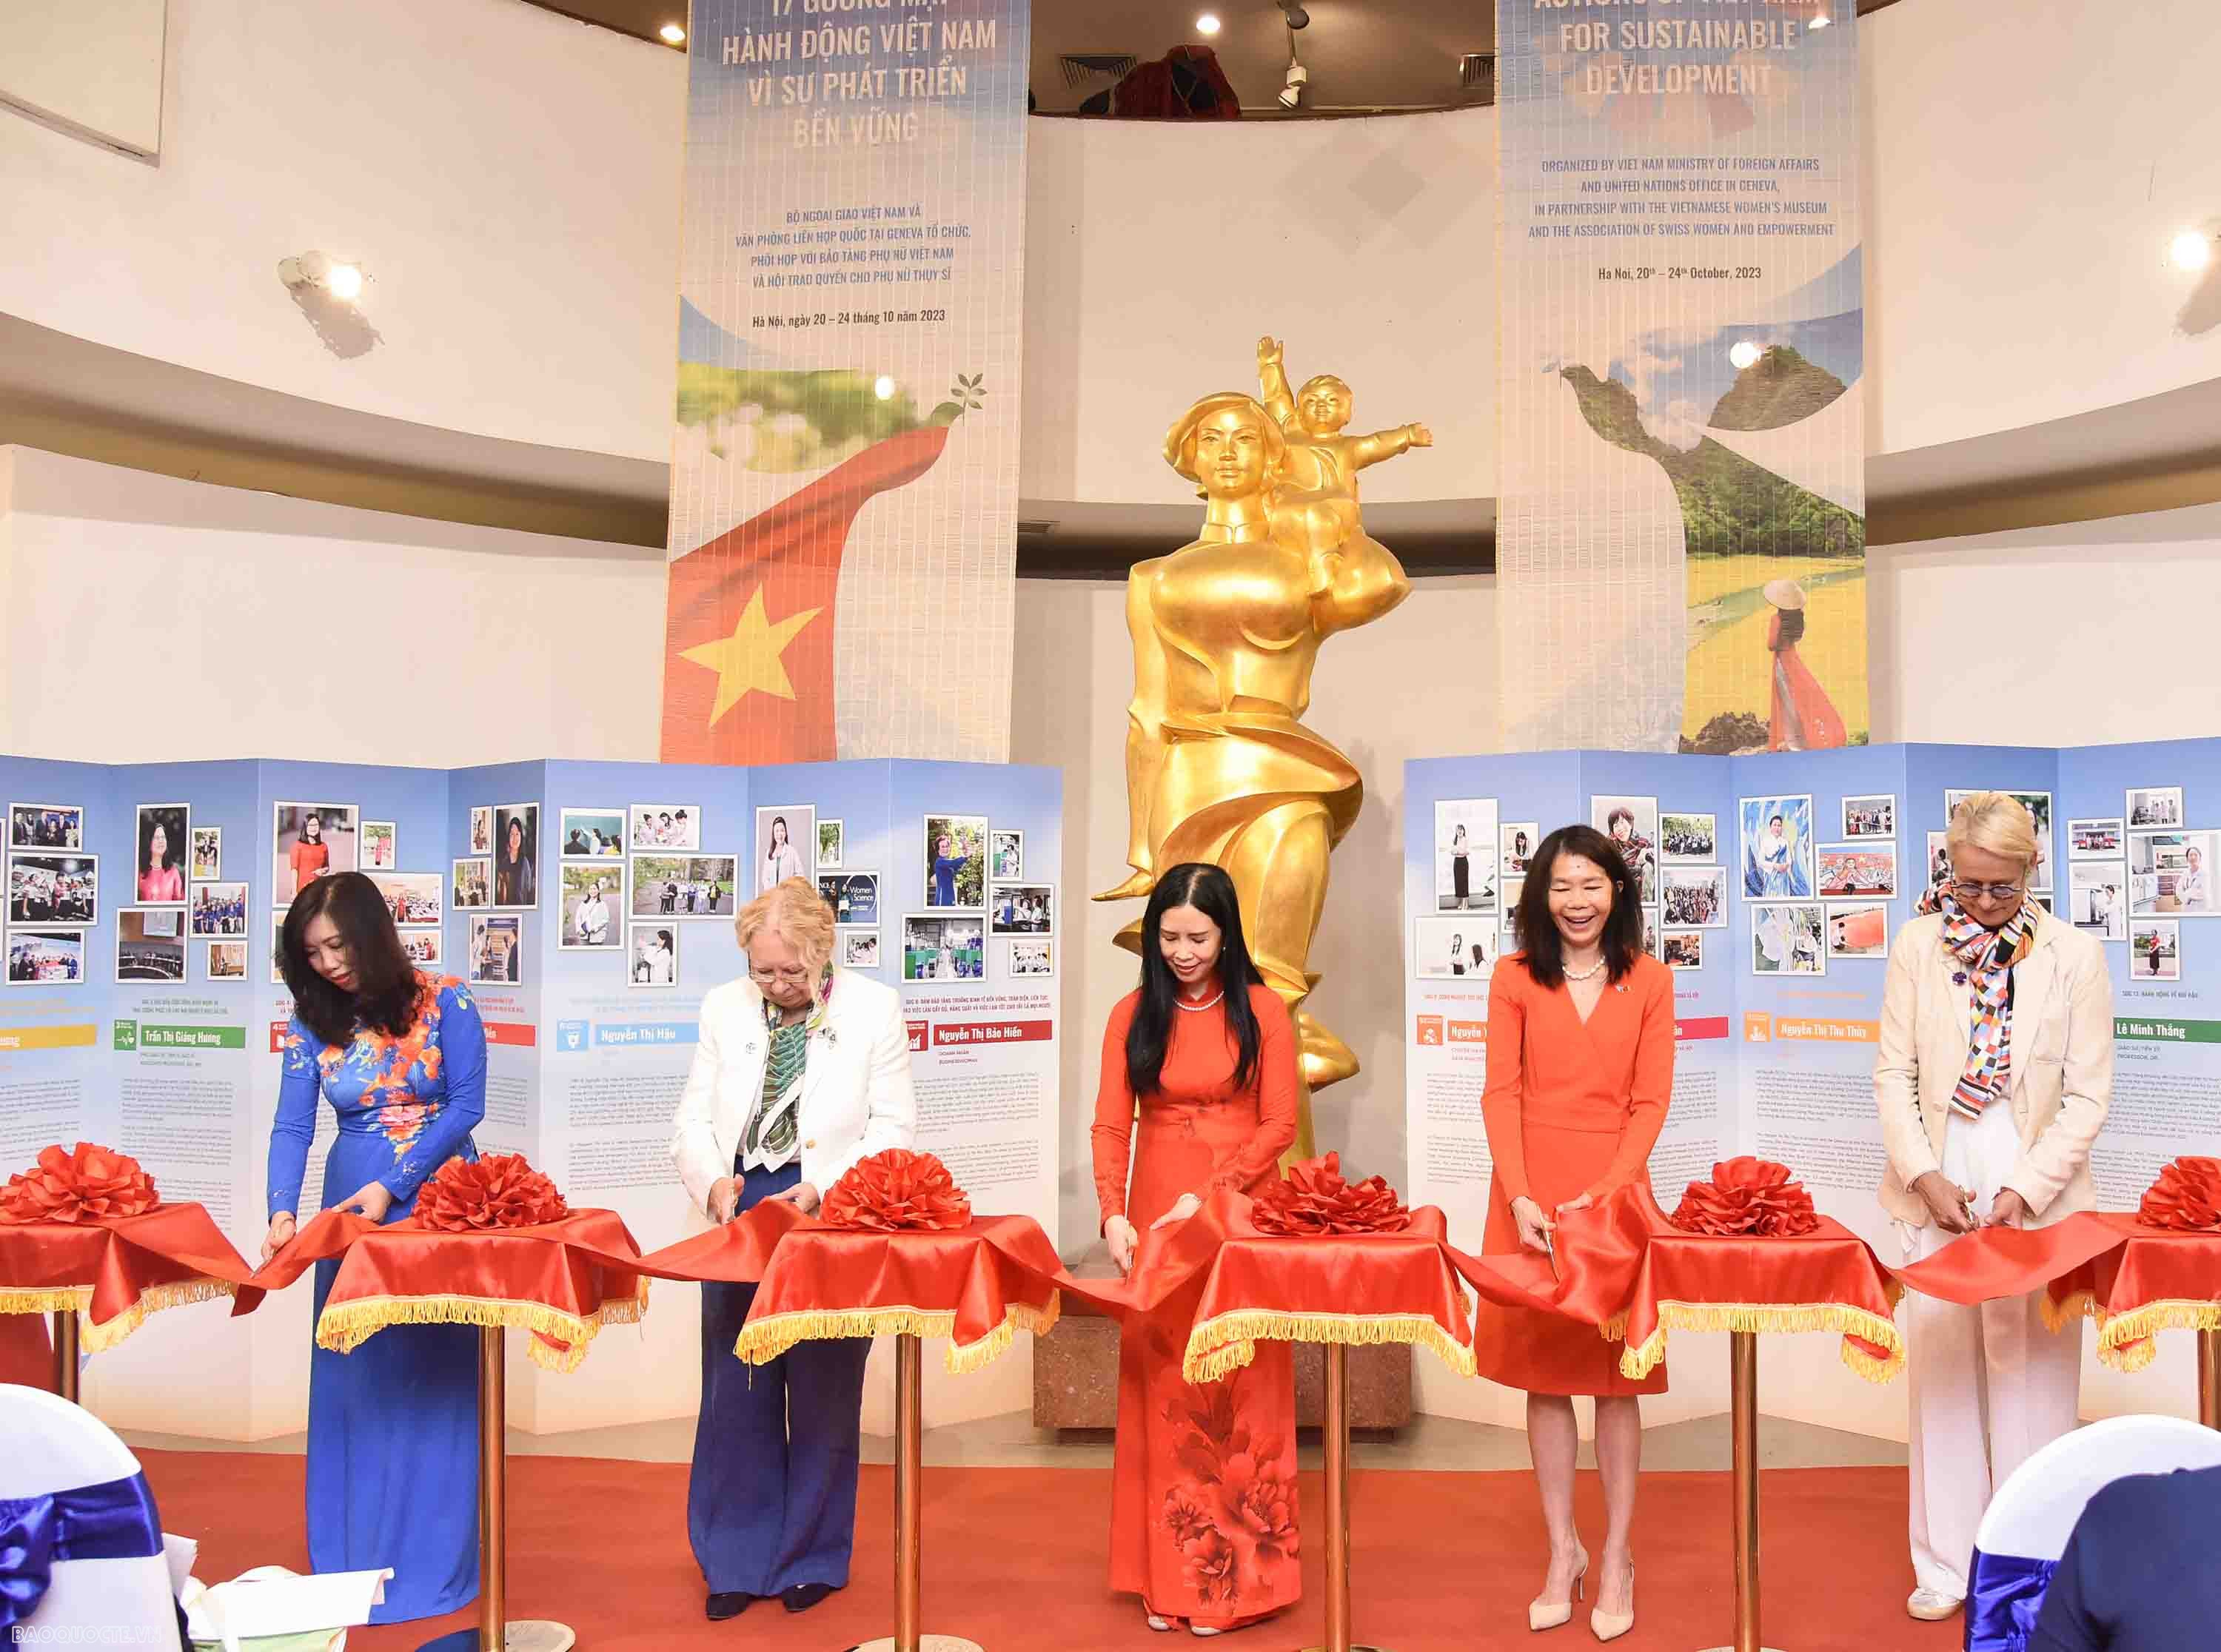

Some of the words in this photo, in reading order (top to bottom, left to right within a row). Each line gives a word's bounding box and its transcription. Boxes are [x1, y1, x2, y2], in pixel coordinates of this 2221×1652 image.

[722, 27, 792, 65] HÀNH
[800, 21, 871, 63] ĐỘNG
[880, 16, 933, 58] VIỆT
[942, 19, 996, 50] NAM
[1561, 22, 1610, 53] FOR
[1621, 19, 1795, 51] SUSTAINABLE
[748, 70, 771, 106] VÌ
[823, 62, 888, 101] PHÁT
[896, 54, 966, 97] TRIỂN
[1587, 64, 1771, 95] DEVELOPMENT
[1542, 159, 1598, 172] ORGANIZED
[1601, 159, 1614, 171] BY
[1618, 158, 1638, 170] VIET
[1642, 158, 1664, 170] NAM
[1667, 158, 1714, 170] MINISTRY
[1718, 158, 1730, 169] OF
[1733, 158, 1776, 170] FOREIGN
[1779, 158, 1819, 171] AFFAIRS
[1581, 181, 1601, 192] AND
[1604, 181, 1640, 192] UNITED
[1644, 180, 1686, 192] NATIONS
[1689, 180, 1722, 191] OFFICE
[1726, 180, 1735, 191] IN
[1740, 180, 1781, 193] GENEVA,
[787, 211, 800, 225] BỘ
[836, 209, 858, 221] GIAO
[862, 205, 882, 221] VIỆT
[884, 206, 905, 218] NAM
[909, 203, 920, 217] VÀ
[1534, 204, 1545, 216] IN
[1548, 202, 1617, 215] PARTNERSHIP
[1620, 202, 1645, 214] WITH
[1649, 202, 1666, 214] THE
[1670, 201, 1730, 213] VIETNAMESE
[1734, 201, 1780, 214] WOMEN'S
[1783, 201, 1827, 214] MUSEUM
[794, 229, 813, 244] LIÊN
[888, 226, 923, 240] GENEVA
[1529, 225, 1549, 238] AND
[1552, 225, 1570, 237] THE
[1574, 224, 1640, 236] ASSOCIATION
[1643, 224, 1655, 235] OF
[1658, 224, 1689, 235] SWISS
[1693, 224, 1729, 235] WOMEN
[1734, 224, 1754, 235] AND
[1758, 224, 1835, 235] EMPOWERMENT
[933, 248, 954, 260] NAM
[753, 273, 764, 288] VÀ
[788, 273, 812, 286] TRAO
[850, 272, 870, 283] CHO
[1598, 267, 1611, 280] Ha
[1615, 267, 1633, 281] Noi,
[1637, 266, 1655, 279] 20th
[1668, 266, 1687, 279] 24th
[1690, 266, 1732, 281] October,
[1735, 266, 1761, 279] 2023
[753, 315, 765, 327] Hà
[768, 314, 785, 329] Nội,
[788, 313, 811, 328] ngày
[814, 313, 825, 325] 20
[838, 312, 849, 324] 24
[853, 312, 880, 325] tháng
[883, 311, 894, 322] 10
[897, 310, 917, 321] năm
[920, 309, 945, 321] 2023
[163, 1030, 174, 1044] Thị
[939, 1027, 969, 1042] Nguyễn
[971, 1028, 984, 1041] Thị
[986, 1027, 1002, 1038] Bảo
[2117, 1023, 2127, 1035] Lê
[2130, 1024, 2153, 1035] Minh
[2156, 1023, 2185, 1039] Thắng
